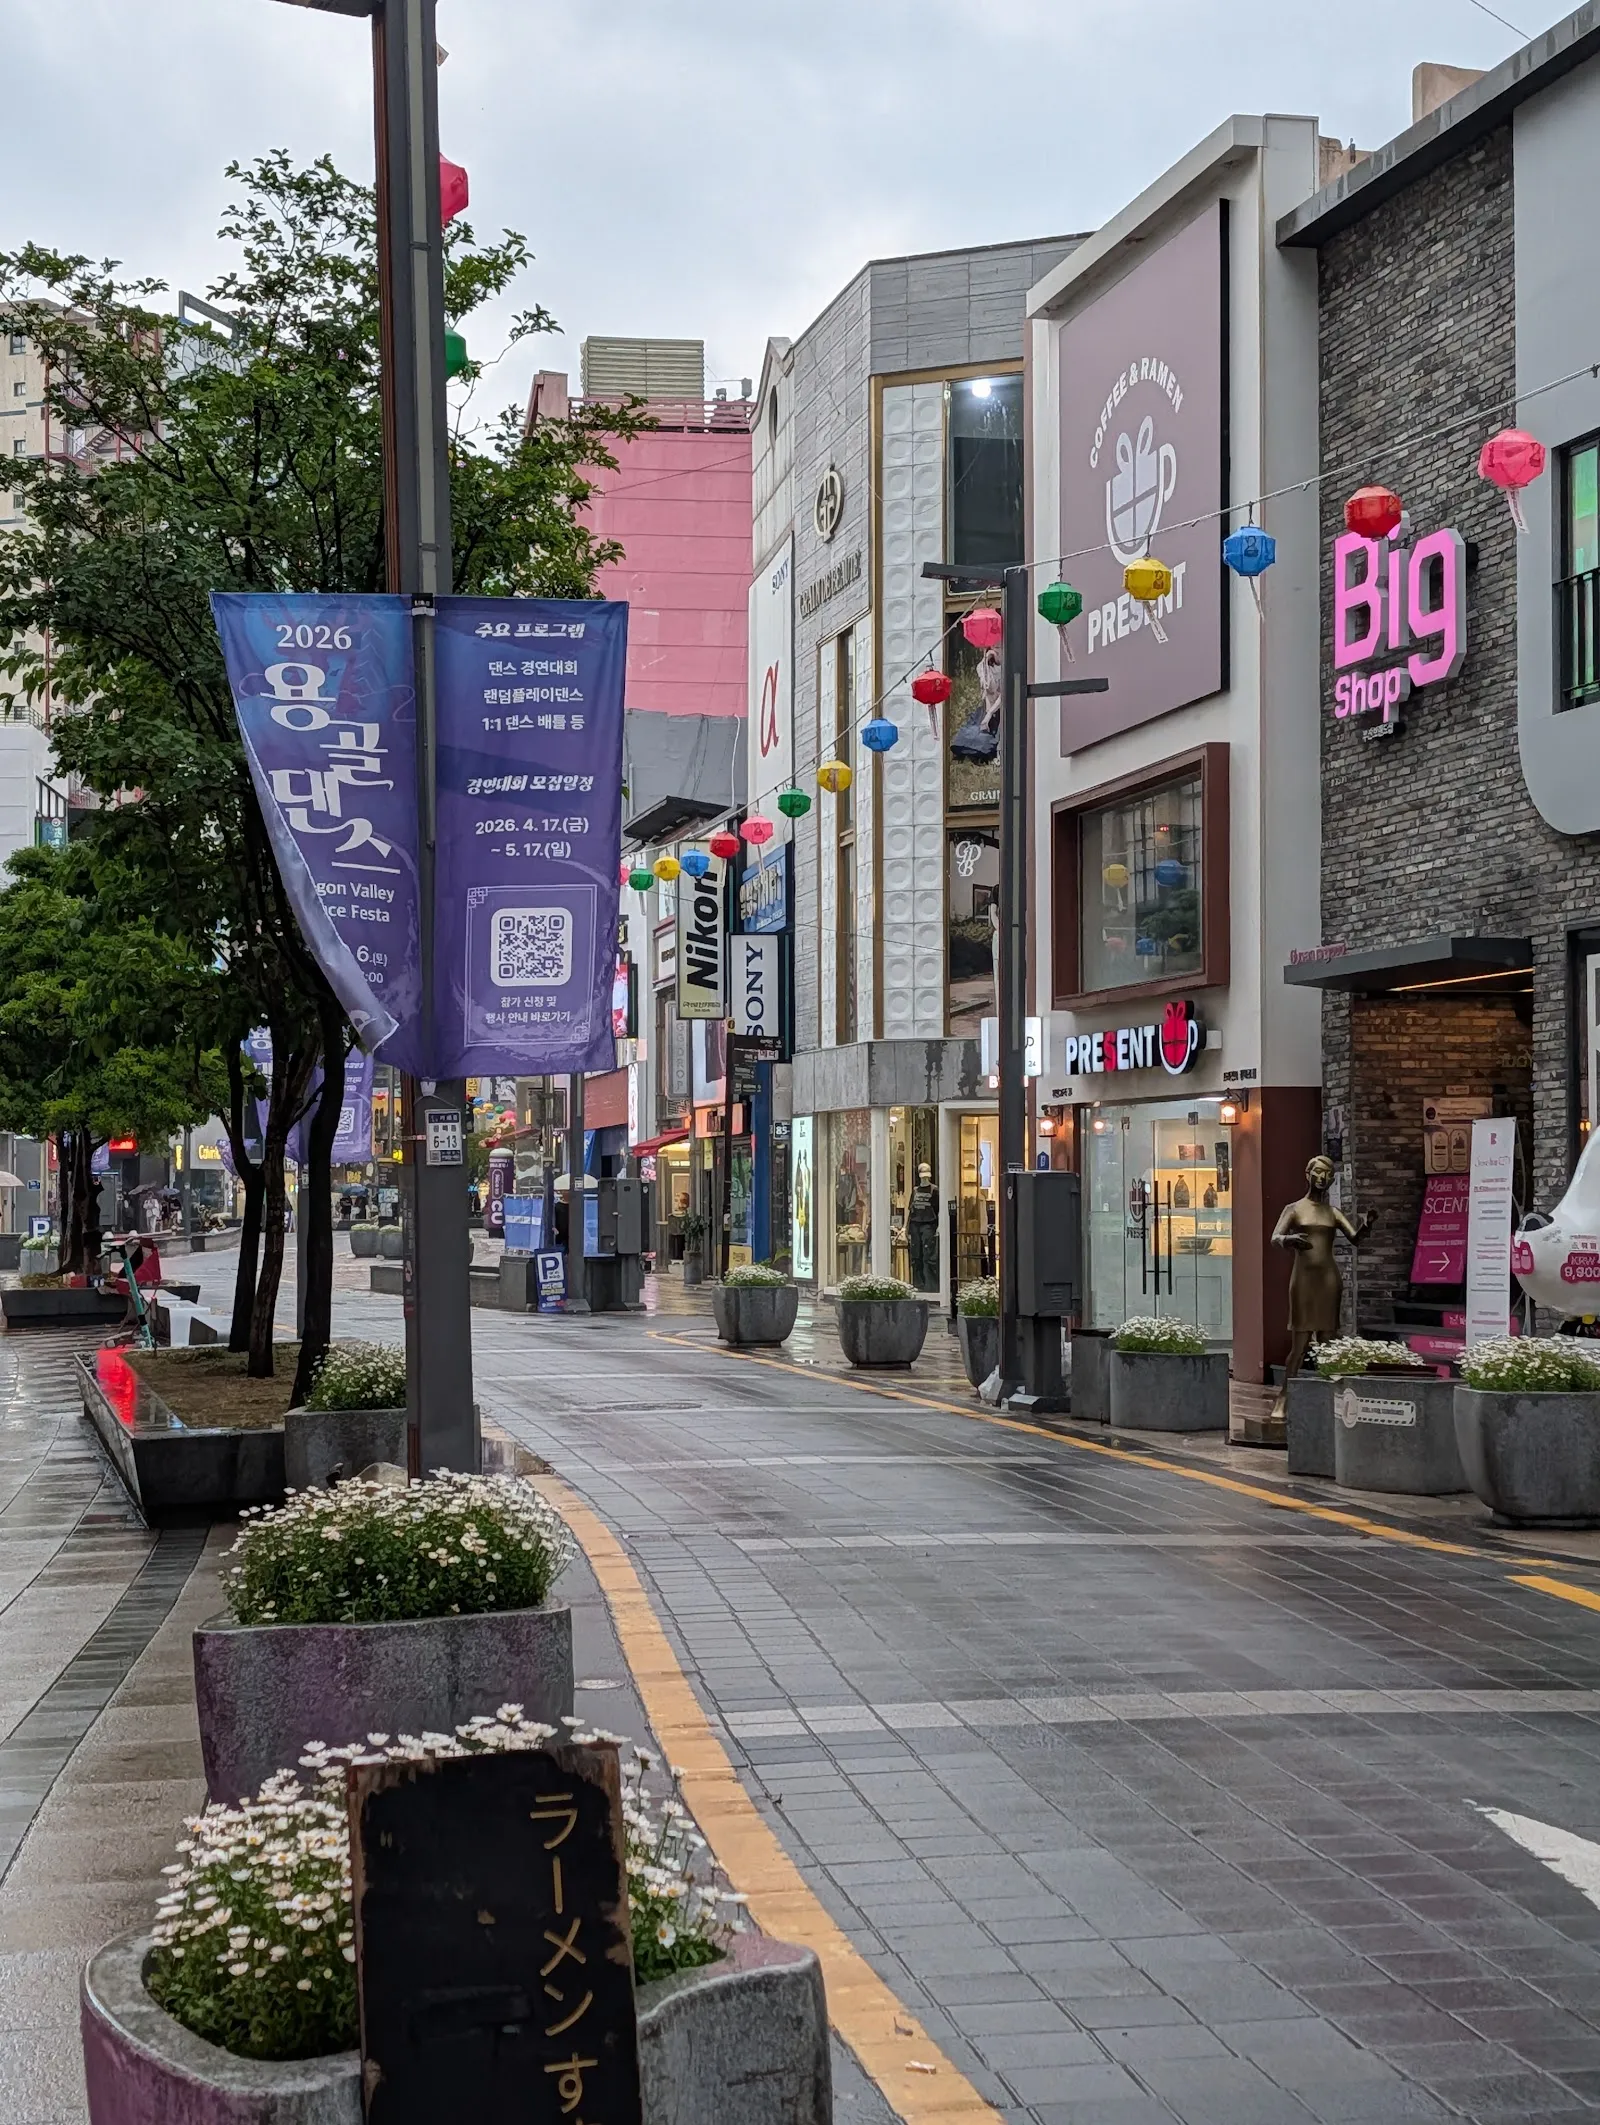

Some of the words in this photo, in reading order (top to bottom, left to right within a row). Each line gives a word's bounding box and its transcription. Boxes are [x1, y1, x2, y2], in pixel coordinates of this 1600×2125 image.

[1089, 371, 1128, 468] COFFEE
[1129, 362, 1138, 386] &
[1140, 357, 1184, 414] RAMEN
[1334, 523, 1458, 687] Big
[276, 624, 352, 650] 2026
[474, 623, 511, 639] 주요
[514, 621, 585, 639] 프로그램
[488, 661, 518, 677] 댄스
[520, 659, 578, 677] 경연대회
[483, 687, 584, 705] 랜덤플레이댄스
[481, 717, 502, 732] 1:1
[505, 714, 534, 731] 댄스
[537, 713, 568, 731] 배틀
[571, 714, 585, 731] 등
[466, 774, 527, 795] 경연대회
[529, 774, 594, 793] 모집일정
[474, 819, 519, 835] 2026.
[522, 819, 540, 833] 4.
[542, 817, 590, 836] 17.(금)
[505, 843, 521, 856] 5.
[523, 841, 572, 858] 17.(일)
[349, 882, 395, 903] Valley
[351, 904, 390, 923] Festa
[686, 871, 719, 991] Nikon
[500, 996, 521, 1008] 참가
[523, 996, 544, 1008] 신청
[546, 996, 557, 1008] 및
[485, 1012, 506, 1024] 행사
[508, 1012, 529, 1024] 안내
[530, 1011, 570, 1024] 바로가기
[1065, 1026, 1156, 1076] PRESENT
[433, 1135, 458, 1149] 6-13
[541, 1256, 560, 1280] P
[530, 1793, 600, 2125] ラーメンす
